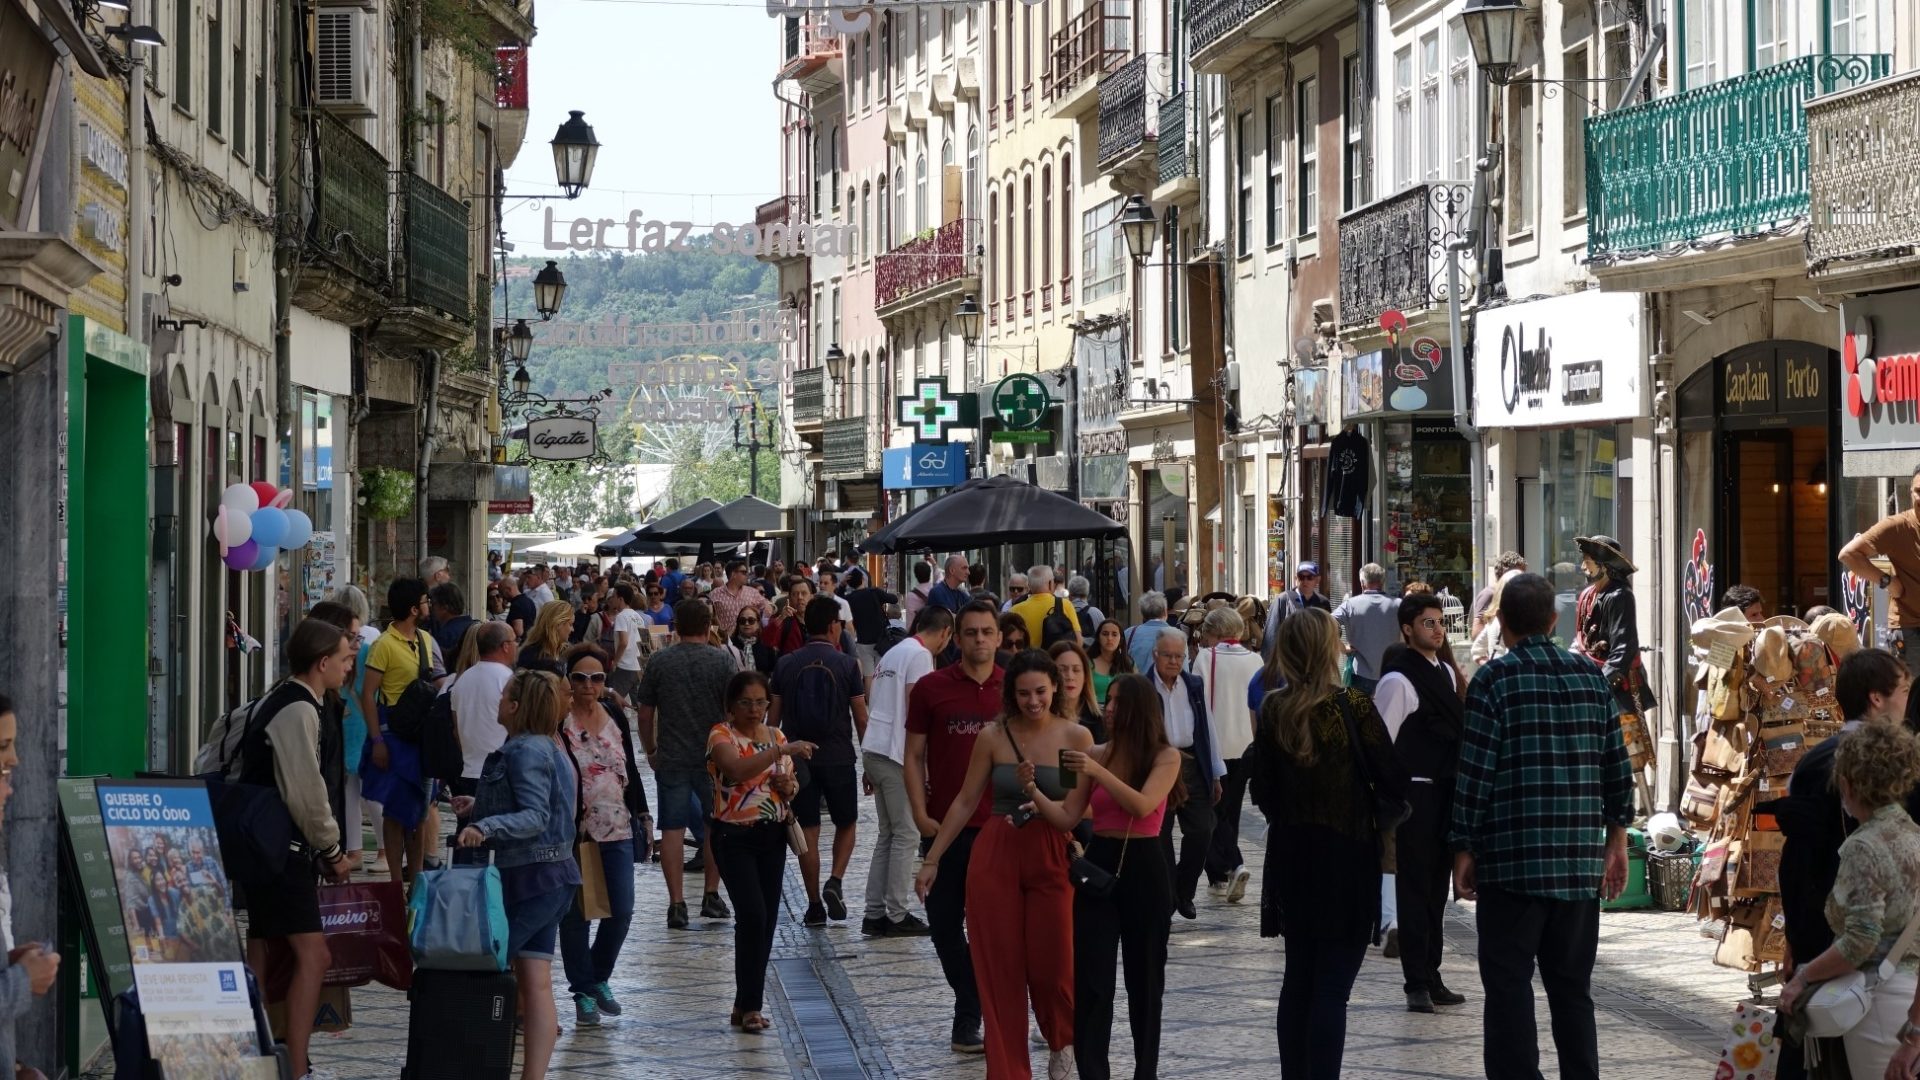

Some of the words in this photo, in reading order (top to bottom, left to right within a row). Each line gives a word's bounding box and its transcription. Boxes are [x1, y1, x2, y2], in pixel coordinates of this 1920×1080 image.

[544, 206, 614, 251] Ler
[626, 209, 693, 251] faz
[713, 213, 858, 257] sonhar
[1725, 362, 1771, 411] Captain
[1786, 356, 1819, 399] Porto
[104, 793, 151, 806] QUEBRE
[153, 794, 162, 806] O
[107, 808, 141, 820] CICLO
[143, 808, 160, 821] DO
[162, 806, 190, 821] ÓDIO
